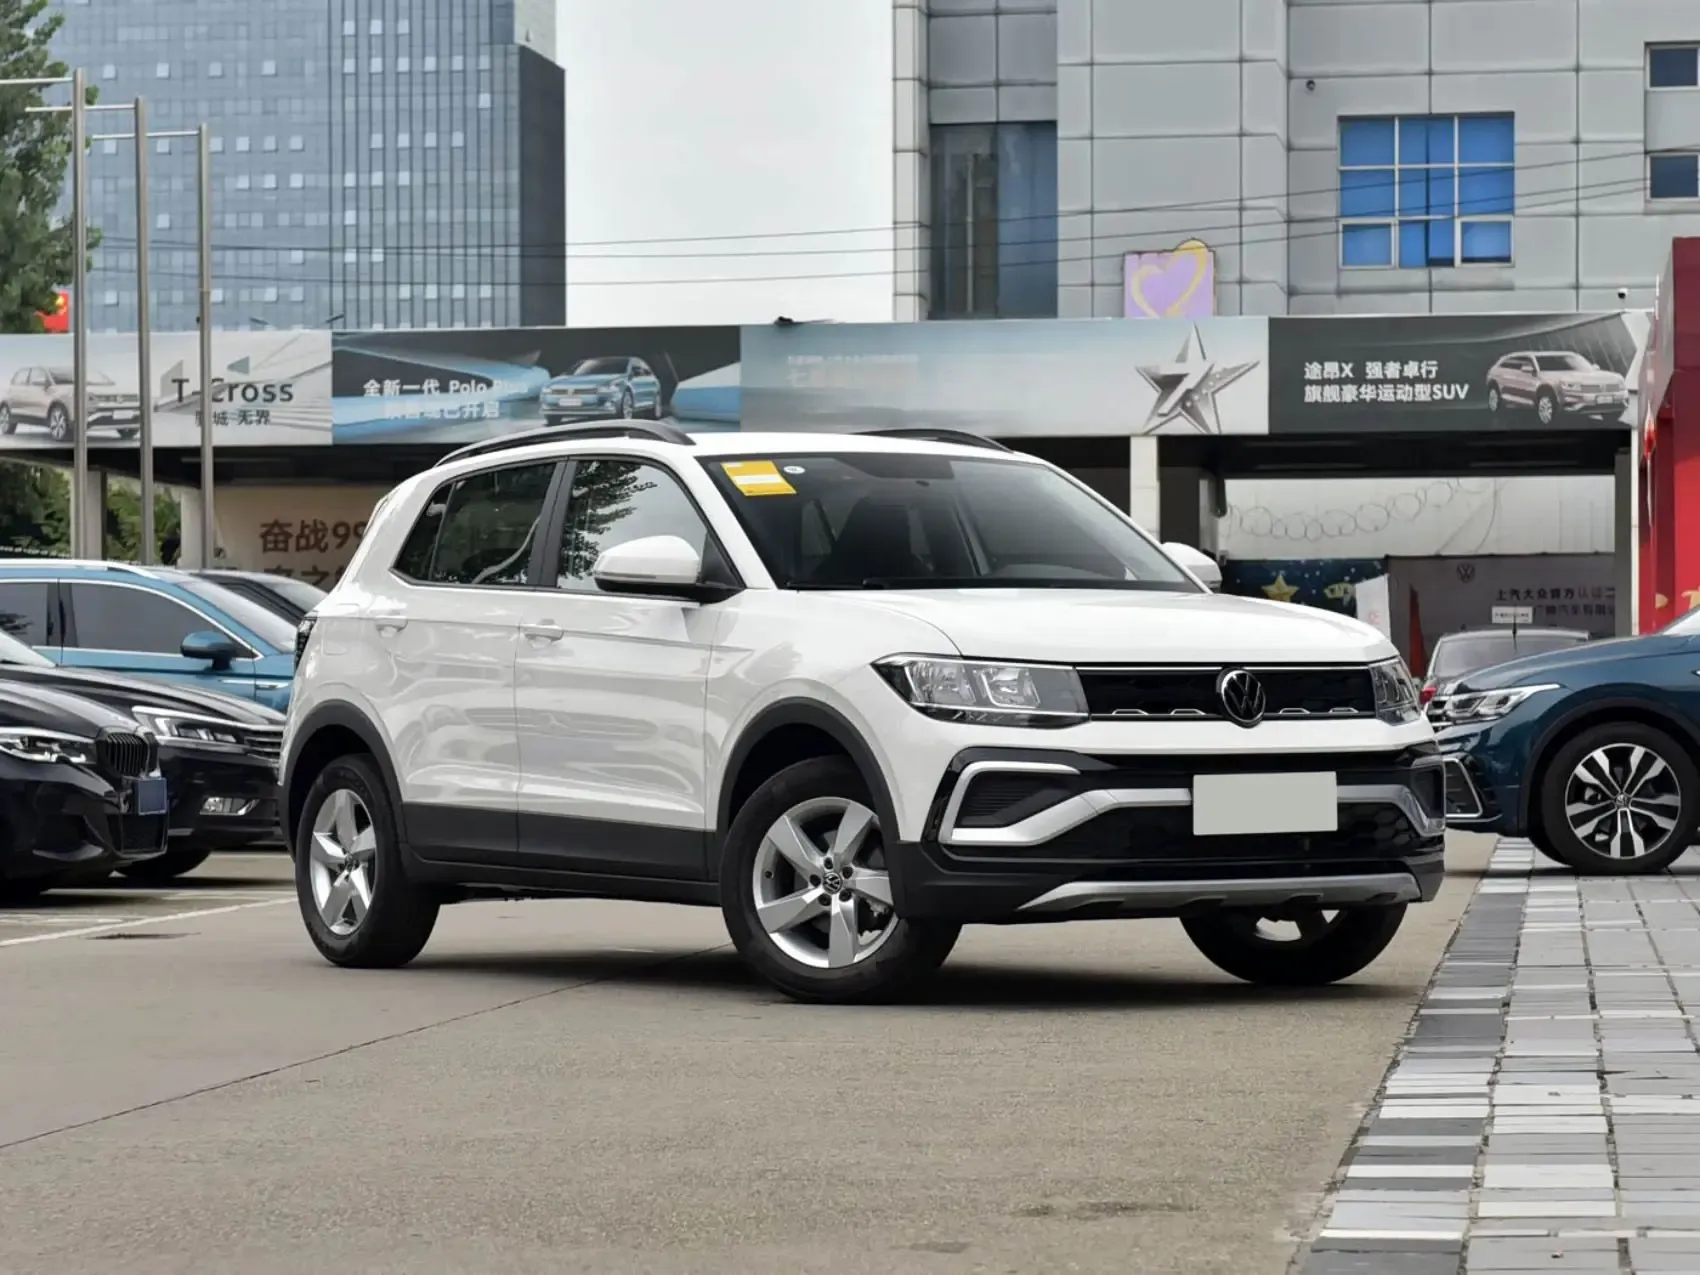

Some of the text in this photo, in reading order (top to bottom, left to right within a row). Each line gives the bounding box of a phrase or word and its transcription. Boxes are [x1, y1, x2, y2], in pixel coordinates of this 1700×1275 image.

[1304, 359, 1440, 380] 途昂X 强者卓行
[170, 376, 295, 404] T-Cross
[363, 379, 440, 397] 全新一代
[450, 379, 487, 395] Polo
[1304, 382, 1470, 404] 旗舰豪华运动型SUV
